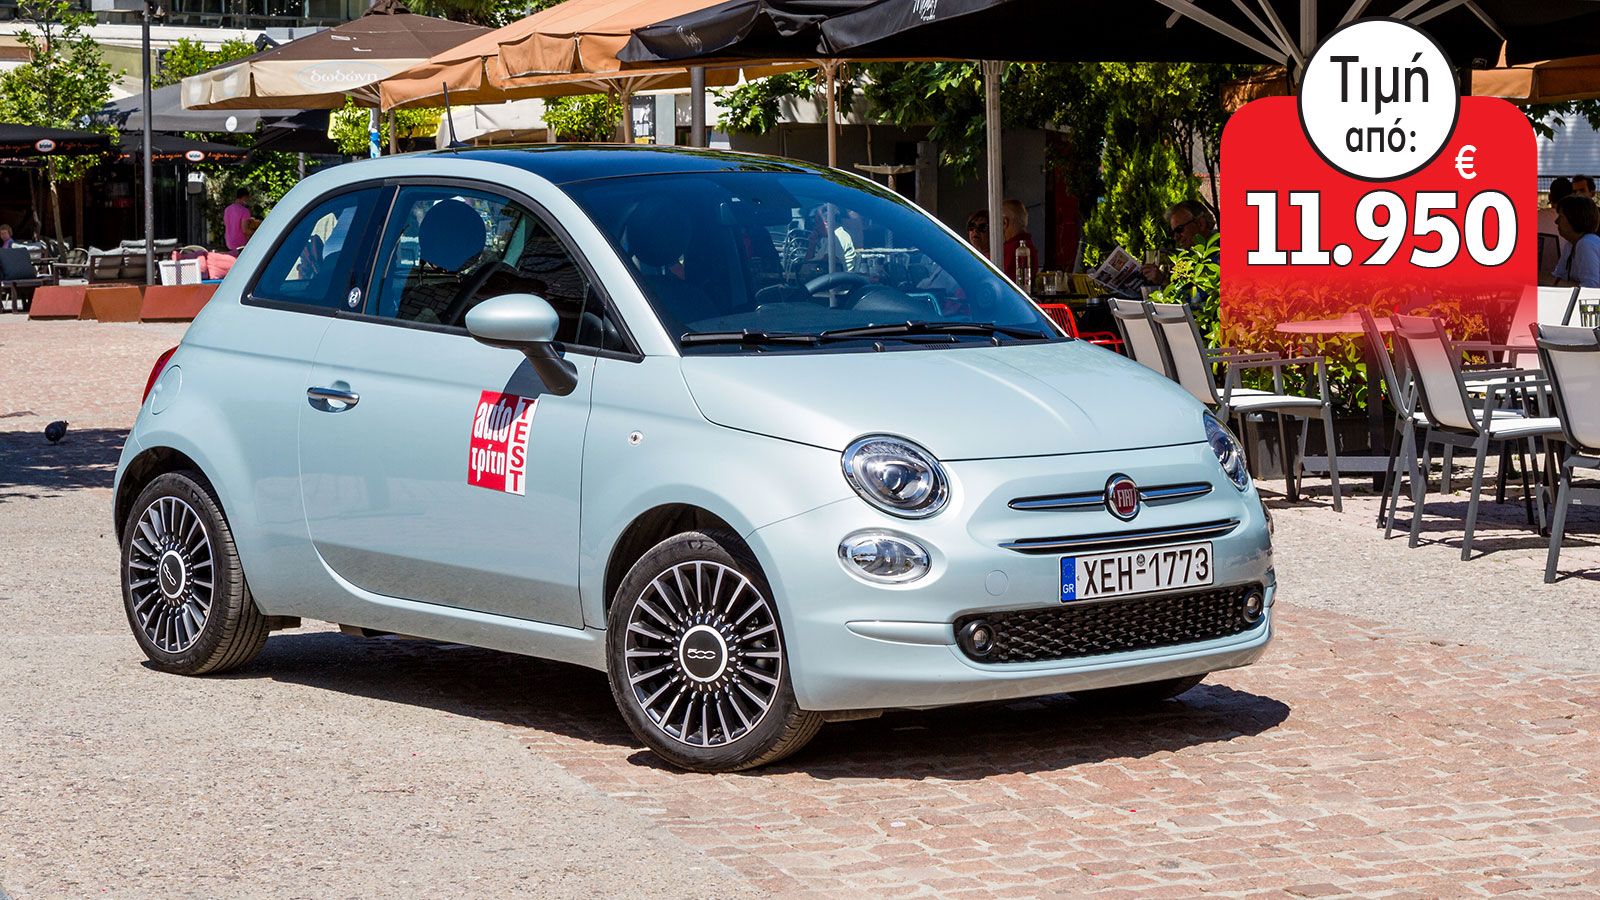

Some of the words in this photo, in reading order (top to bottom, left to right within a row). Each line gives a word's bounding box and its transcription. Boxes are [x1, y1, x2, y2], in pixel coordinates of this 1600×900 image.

[473, 398, 513, 443] auto
[471, 444, 506, 482] τρίτη
[509, 399, 535, 492] TEST
[1117, 488, 1134, 507] FIAT
[1062, 583, 1075, 594] GR
